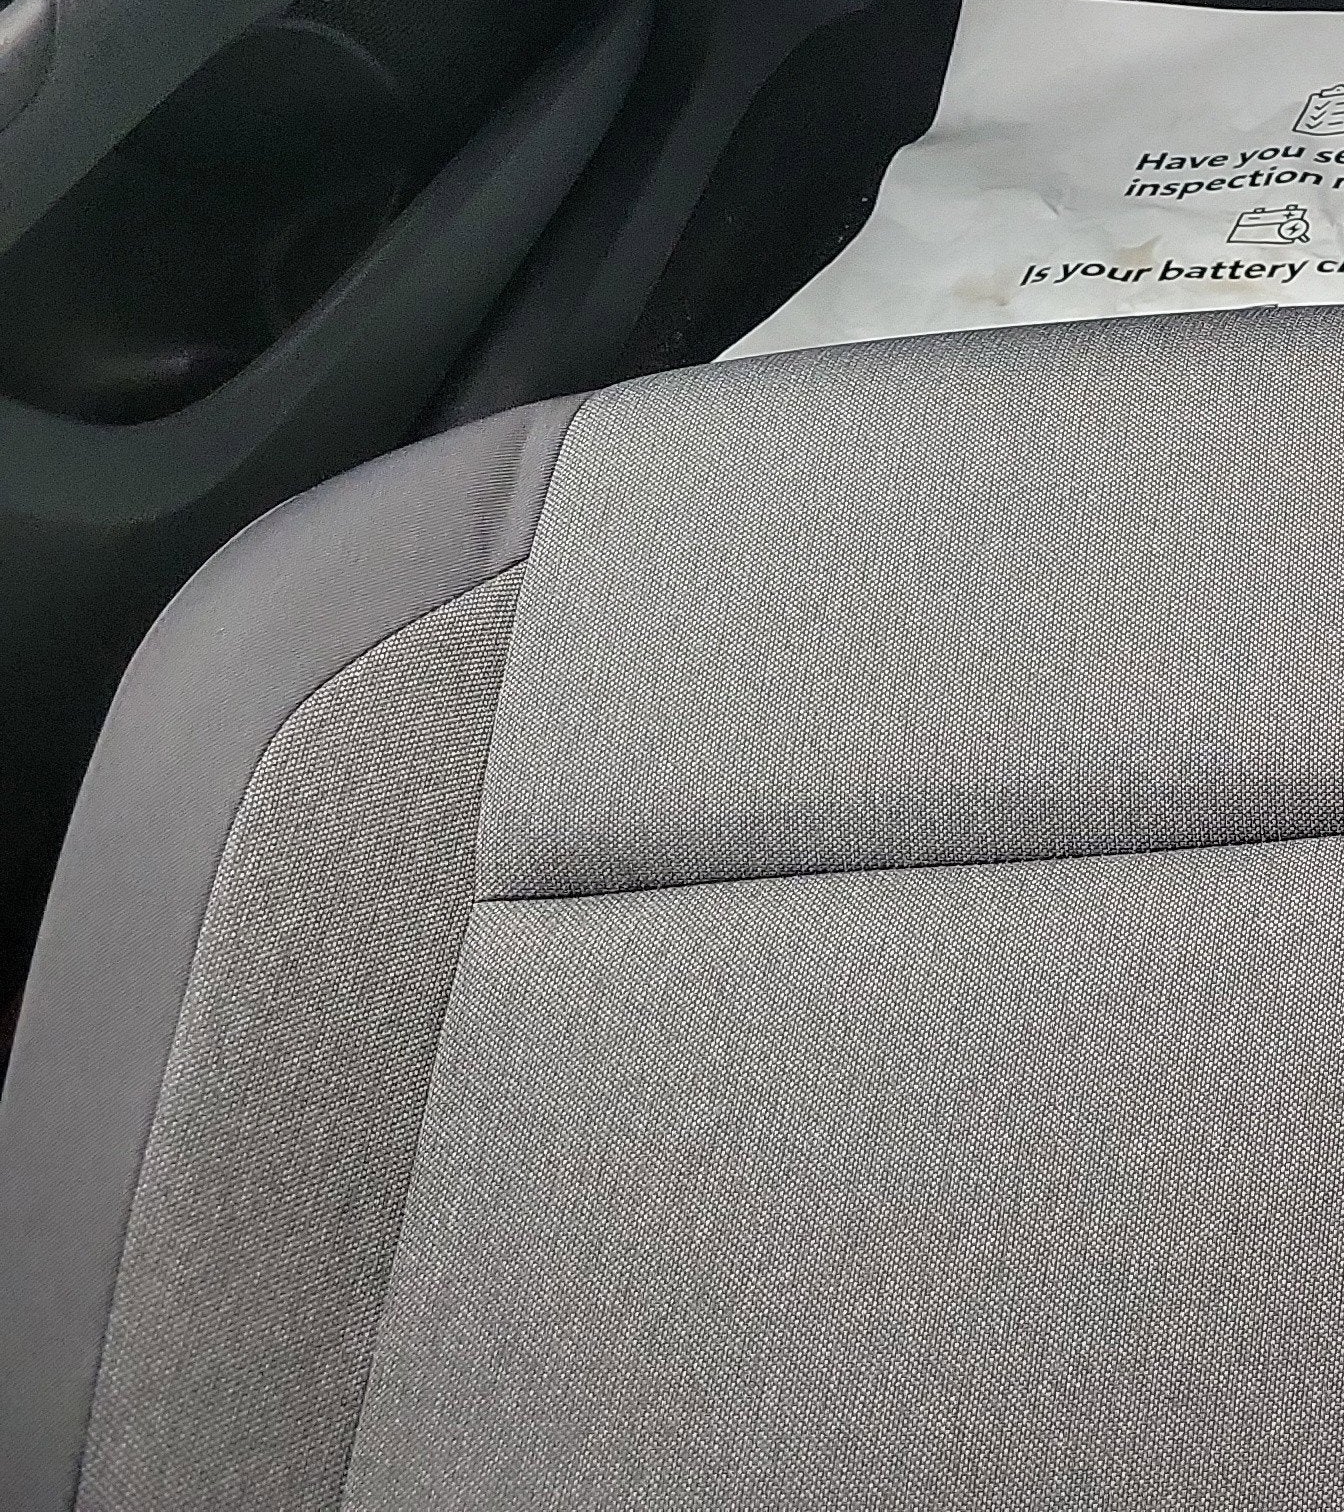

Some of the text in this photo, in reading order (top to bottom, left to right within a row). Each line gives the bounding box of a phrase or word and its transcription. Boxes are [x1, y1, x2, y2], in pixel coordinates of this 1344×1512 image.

[1136, 151, 1229, 172] Have
[1234, 144, 1306, 169] you
[1123, 166, 1323, 201] inspection
[1020, 264, 1049, 287] Is
[1053, 261, 1152, 284] your
[1158, 259, 1312, 284] battery
